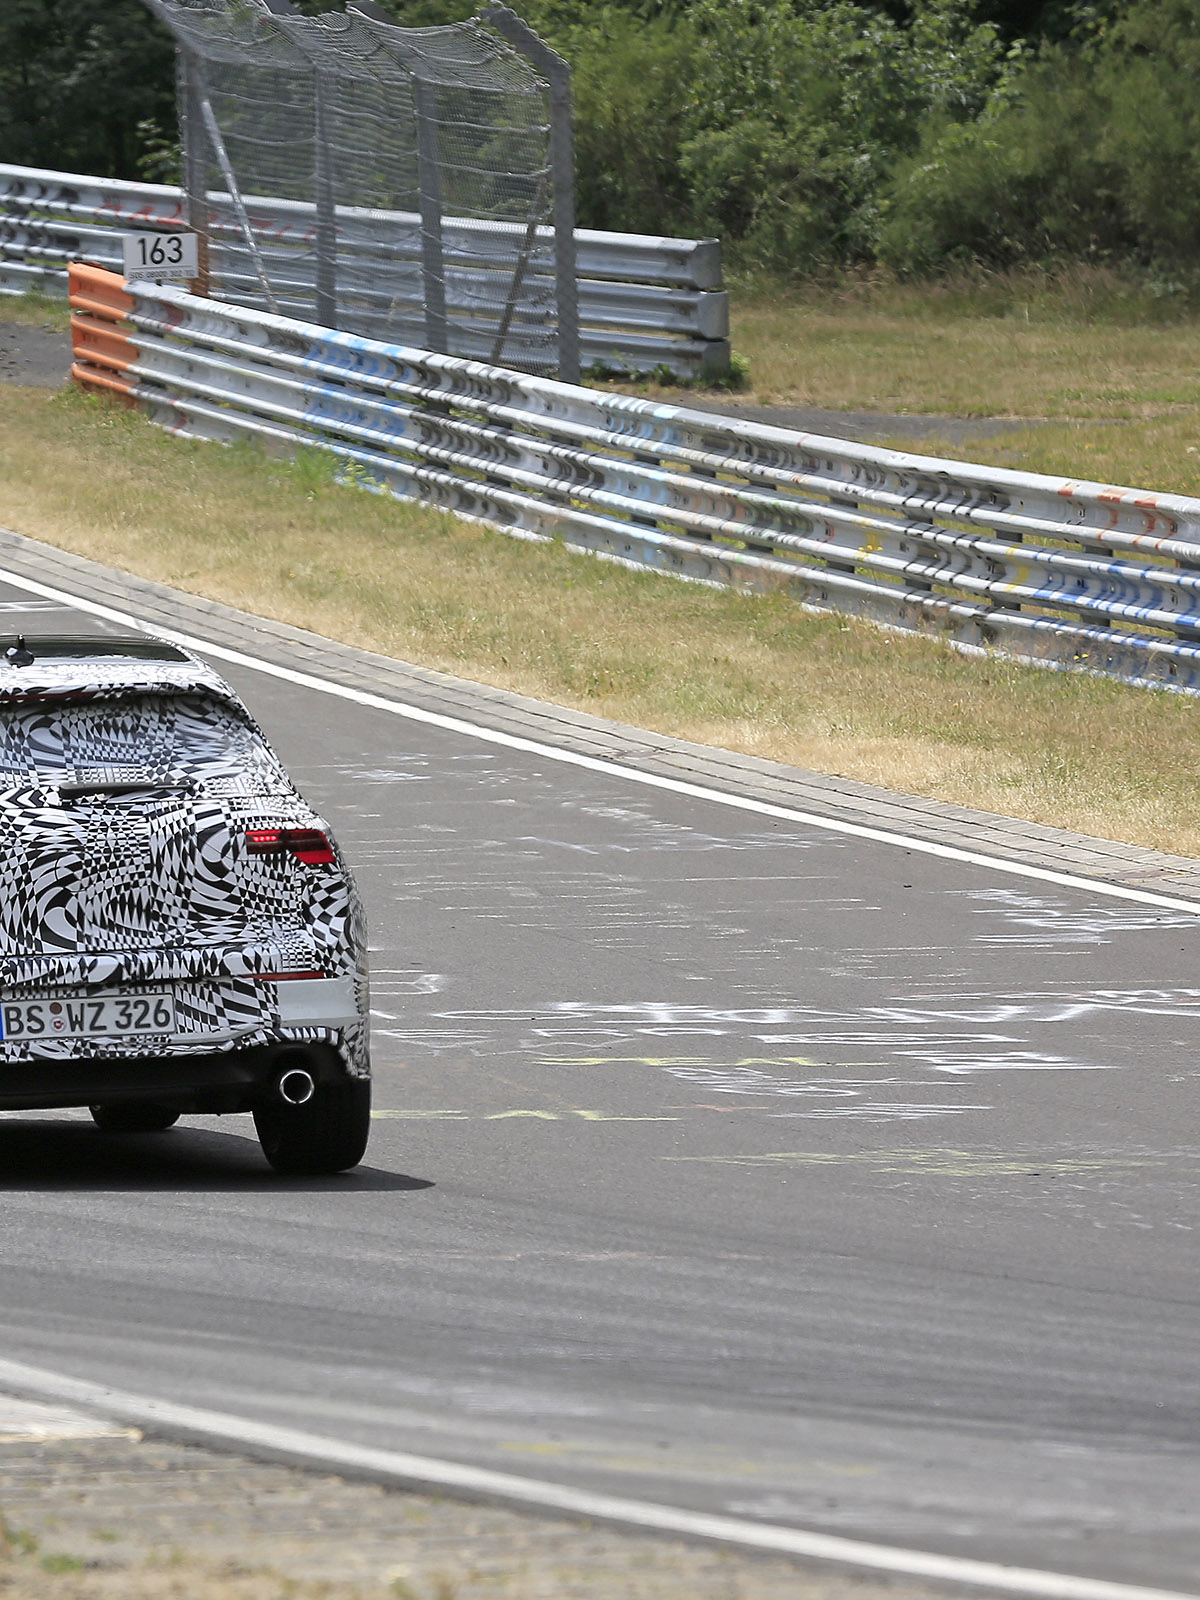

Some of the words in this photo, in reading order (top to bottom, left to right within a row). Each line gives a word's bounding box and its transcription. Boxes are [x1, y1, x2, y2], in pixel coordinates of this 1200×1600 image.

[138, 236, 183, 265] 163
[4, 1005, 46, 1036] BS
[66, 1002, 107, 1032] WZ
[115, 998, 171, 1029] 326
